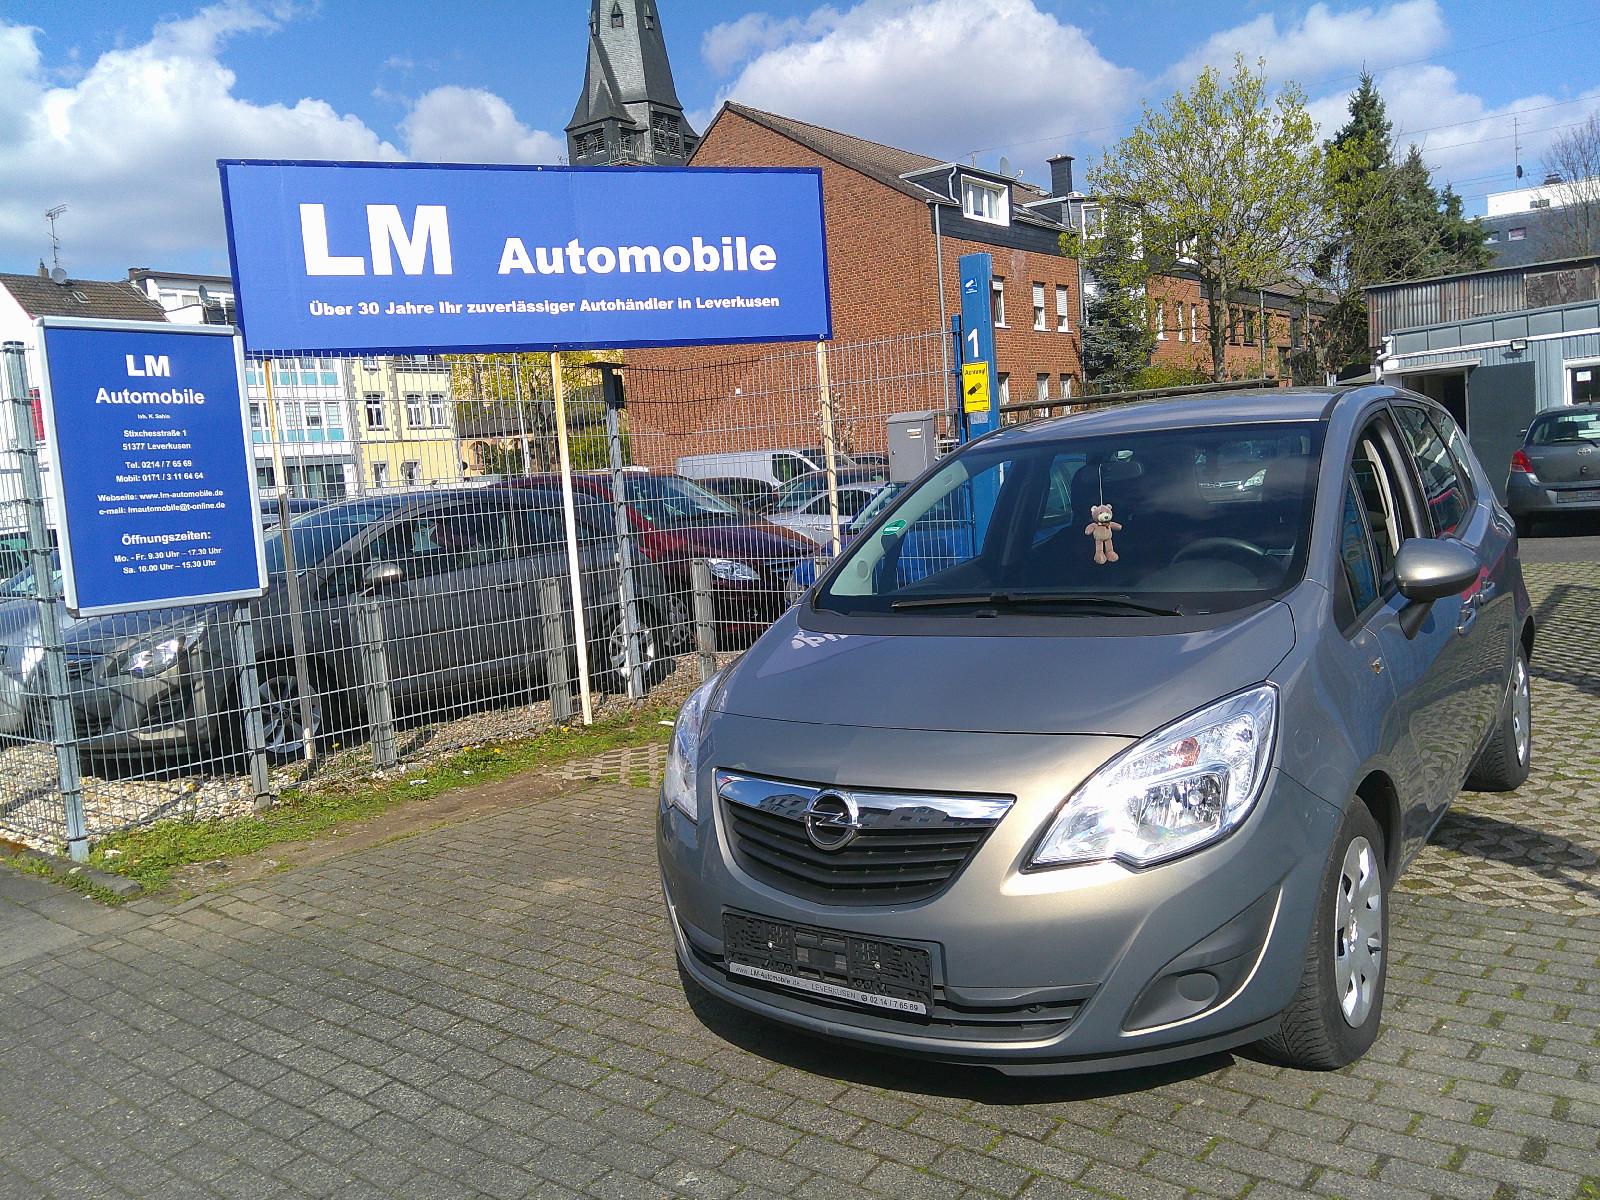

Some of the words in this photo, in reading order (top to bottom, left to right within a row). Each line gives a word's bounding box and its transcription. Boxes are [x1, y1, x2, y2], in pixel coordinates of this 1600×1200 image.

[299, 203, 453, 276] LM
[497, 236, 777, 275] Automobile
[309, 300, 352, 316] Über
[358, 301, 380, 315] 30
[385, 301, 435, 315] Jahre
[439, 301, 462, 314] Ihr
[467, 300, 575, 315] zuverlässiger
[580, 298, 673, 312] Autohändler
[677, 297, 692, 309] in
[695, 296, 780, 309] Leverkusen
[967, 328, 979, 358] 1
[126, 355, 170, 376] LM
[95, 388, 205, 404] Automobile
[123, 429, 181, 438] Stixchesstraße
[182, 429, 187, 437] 1
[122, 442, 145, 451] 51377
[147, 442, 192, 450] Leverkusen
[125, 461, 140, 469] Tel.
[183, 459, 192, 467] 69
[116, 475, 141, 483] Mobil:
[142, 474, 160, 482] 0171
[166, 473, 172, 481] 3
[184, 472, 193, 480] 64
[97, 493, 138, 502] Webseite:
[139, 489, 224, 500] www.lm-automobile.de
[98, 507, 127, 515] e-mail:
[121, 531, 211, 545] Öffnungszeiten:
[114, 554, 129, 563] Mo.
[135, 553, 147, 561] Fr.
[148, 551, 164, 560] 9.30
[165, 550, 180, 558] Uhr
[187, 548, 207, 556] 17.30
[208, 547, 222, 555] Uhr
[123, 566, 136, 574] Sa.
[138, 564, 158, 573] 10.00
[159, 563, 174, 571] Uhr
[182, 560, 202, 569] 15.30
[202, 559, 217, 567] Uhr
[811, 983, 856, 999] LEVERKUSEN
[869, 996, 878, 1004] 02
[880, 998, 888, 1006] 14
[893, 1000, 898, 1008] 7
